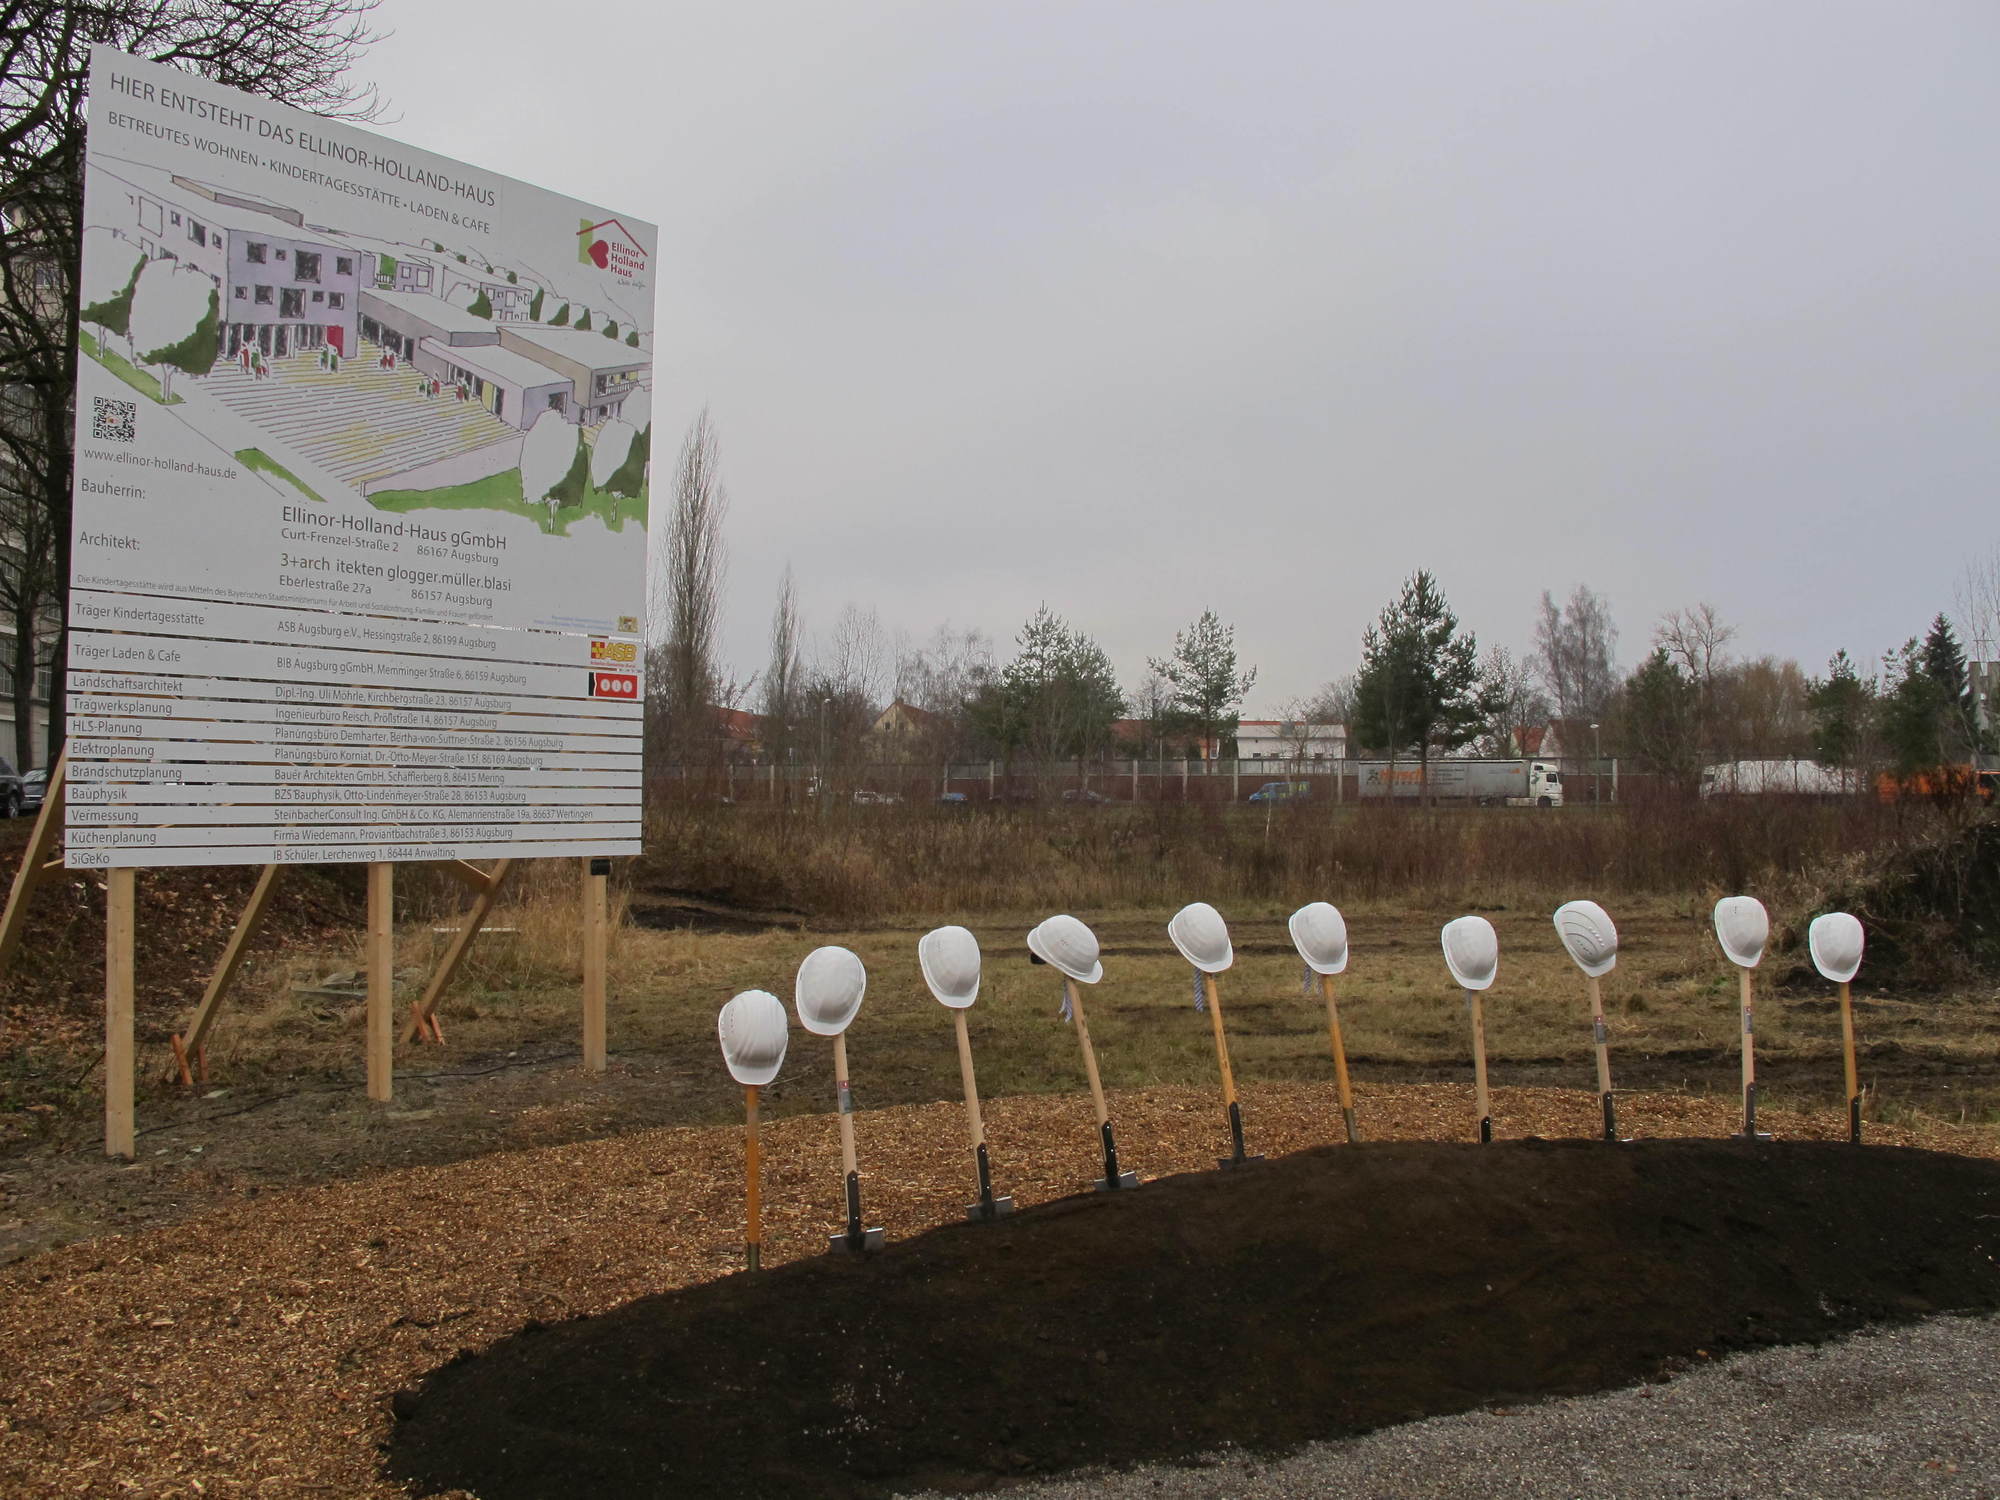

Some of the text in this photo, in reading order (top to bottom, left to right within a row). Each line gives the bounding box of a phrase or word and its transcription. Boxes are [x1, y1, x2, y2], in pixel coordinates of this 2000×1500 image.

[110, 72, 496, 207] HIER ENTSTEHT DAS ELLINOR-HOLLAND-HAUS
[108, 111, 490, 234] BETREUTES WOHNEN KINDERTAGESSTÄTTE LADEN & CAFE
[611, 242, 640, 258] Ellinor
[611, 253, 645, 270] Holland
[610, 264, 633, 278] Haus
[84, 449, 237, 480] www.ellinor-holland-haus.de
[81, 478, 146, 499] Bauherrin:
[282, 506, 507, 550] Ellinor-Holland-Haus gGmbH
[79, 530, 140, 551] Architekt:
[281, 527, 499, 567] Curt-Frenzel-Straße 2 86167 Augsburg
[387, 566, 511, 592] glogger.müller.blasi
[279, 575, 493, 609] Eberlestraße 27a 86157 Augsburg
[277, 621, 296, 633] ASB
[298, 623, 342, 639] Augsburg
[364, 628, 421, 643] Hessingstraße
[432, 634, 457, 645] 86199
[459, 637, 497, 651] Augsburg
[112, 647, 145, 661] Laden
[148, 649, 155, 661] &
[158, 650, 181, 662] Cafe
[277, 657, 292, 669] BIB
[294, 658, 338, 673] Augsburg
[377, 664, 427, 680] Memminger
[429, 667, 455, 680] Straße
[465, 670, 489, 681] 86159
[490, 672, 527, 686] Augsburg
[73, 676, 183, 692] Landschaftsarchitekt
[73, 699, 173, 715] Tragwerksplanung
[73, 721, 142, 736] HLS-Planung
[72, 743, 155, 758] Elektroplanung
[72, 765, 182, 780] Brandschutzplanung
[72, 788, 127, 800] Bauphysik
[71, 810, 139, 823] Vermessung
[71, 831, 156, 845] Küchenplanung
[71, 853, 110, 865] SiGeKo
